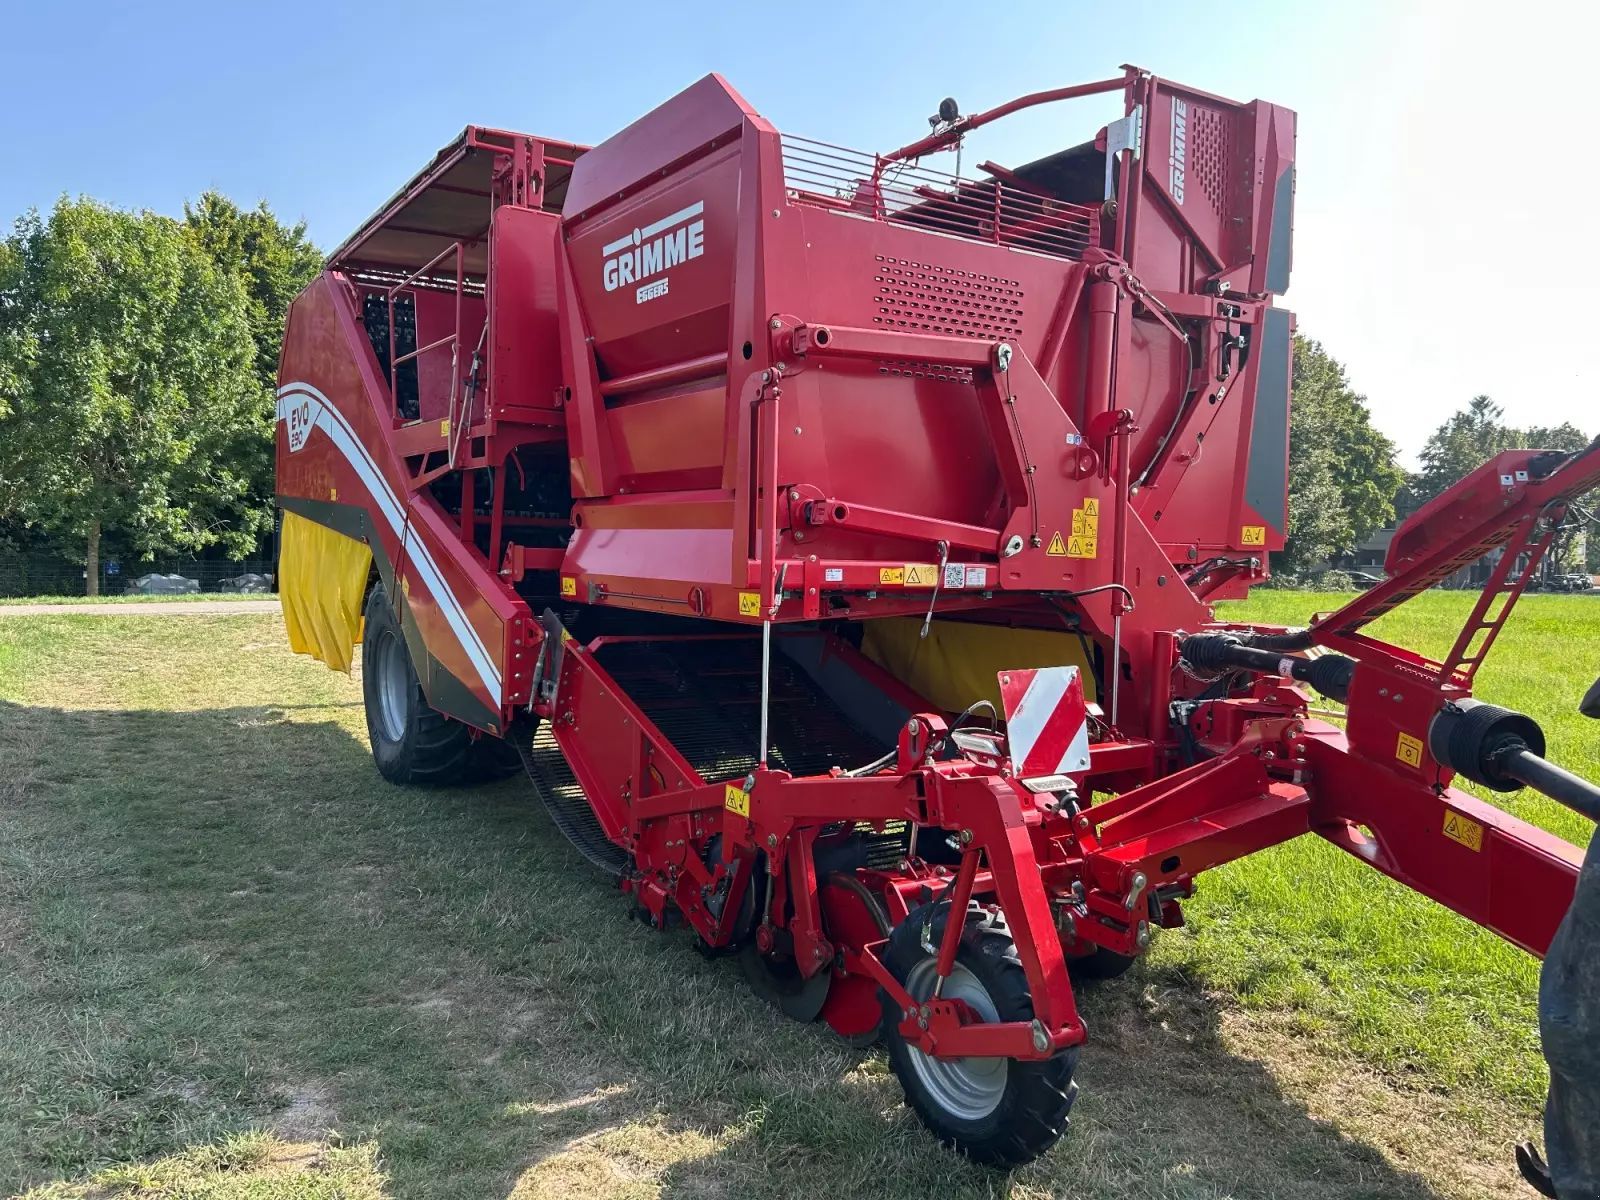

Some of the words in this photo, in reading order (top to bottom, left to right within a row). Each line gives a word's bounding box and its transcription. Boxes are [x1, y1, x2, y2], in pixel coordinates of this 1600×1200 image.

[1171, 97, 1187, 206] GRIMME
[603, 216, 704, 292] GRIMME
[636, 278, 669, 304] EGGERS
[291, 401, 309, 431] EVO
